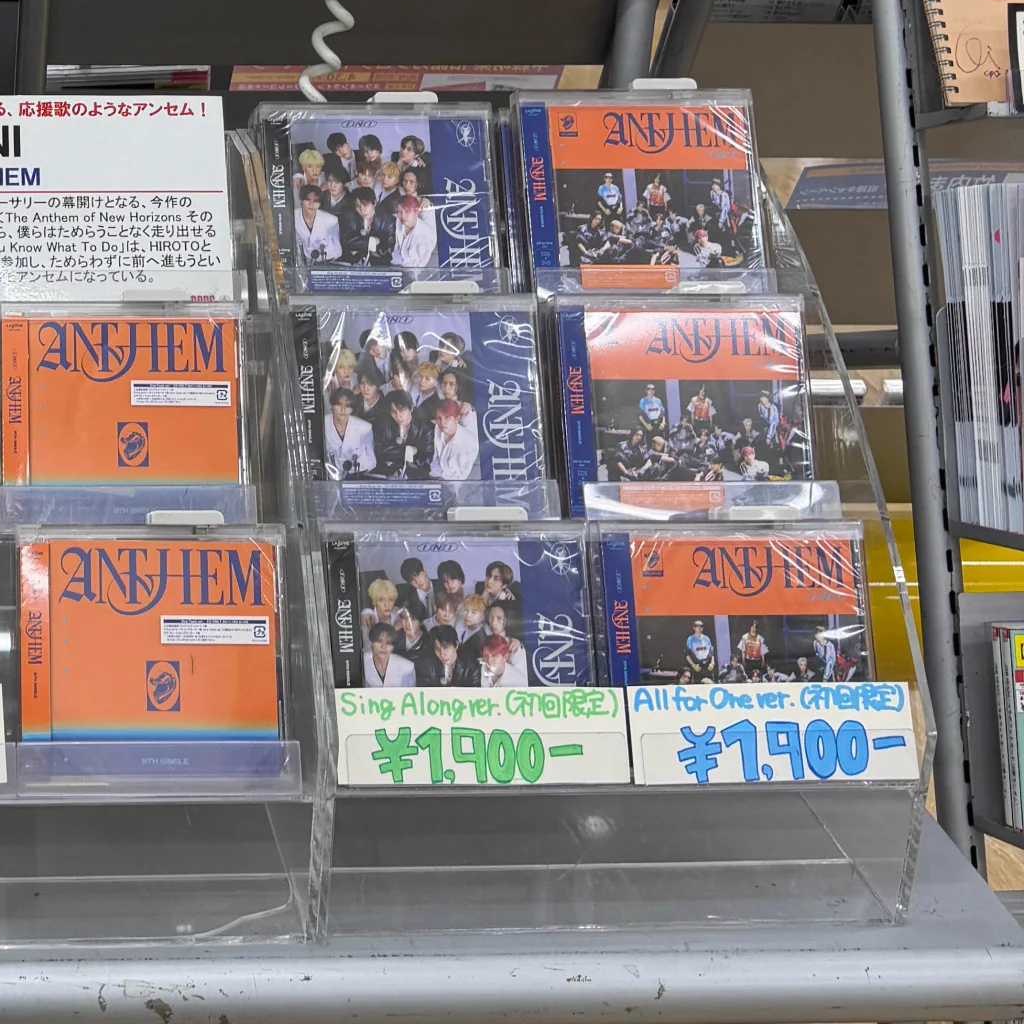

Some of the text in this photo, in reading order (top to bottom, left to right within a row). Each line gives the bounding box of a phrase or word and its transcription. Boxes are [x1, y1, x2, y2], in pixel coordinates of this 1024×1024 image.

[603, 111, 736, 154] ANTHEM
[33, 211, 79, 223] Anthem
[83, 211, 95, 222] of
[99, 211, 125, 222] New
[130, 211, 182, 222] Horizons
[187, 210, 213, 223] その
[440, 177, 484, 281] ANTHE
[10, 242, 42, 253] Know
[47, 242, 77, 253] What
[83, 242, 97, 253] To
[37, 321, 232, 382] ANTHEM
[58, 546, 266, 616] ANTHEM
[692, 546, 844, 597] ANTHEM
[335, 599, 354, 653] ANTHEM
[611, 600, 632, 654] ANTHEM
[340, 692, 396, 721] Sing
[401, 692, 467, 722] Along
[634, 687, 669, 712] All
[675, 689, 709, 712] for
[709, 688, 753, 710] One
